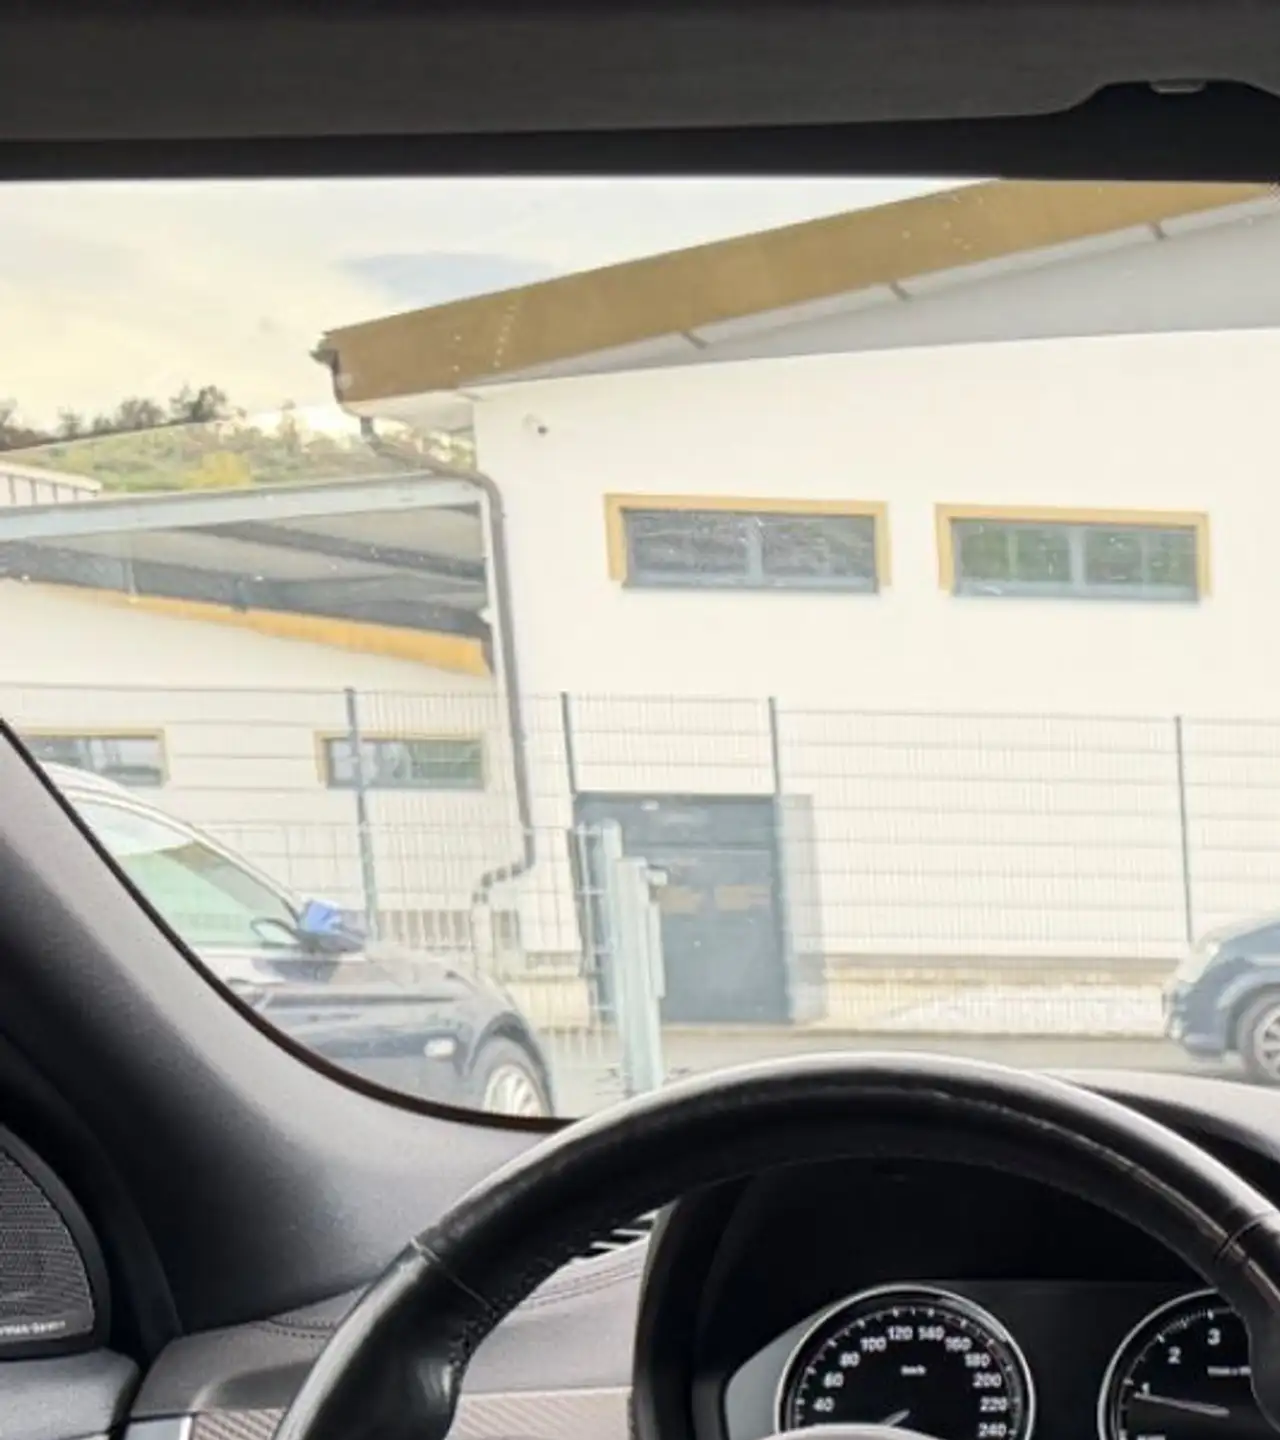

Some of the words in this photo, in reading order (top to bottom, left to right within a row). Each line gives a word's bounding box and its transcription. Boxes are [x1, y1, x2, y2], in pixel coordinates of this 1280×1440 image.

[887, 1325, 914, 1341] 120
[918, 1325, 946, 1341] 140
[1207, 1328, 1220, 1346] 3
[860, 1336, 887, 1352] 100
[944, 1336, 973, 1352] 160
[839, 1351, 861, 1368] 80
[964, 1352, 991, 1368] 180
[1168, 1346, 1181, 1364] 2
[823, 1371, 845, 1389] 60
[973, 1371, 1002, 1389] 200
[812, 1397, 835, 1413] 40
[980, 1396, 1008, 1413] 220
[978, 1422, 1007, 1439] 240
